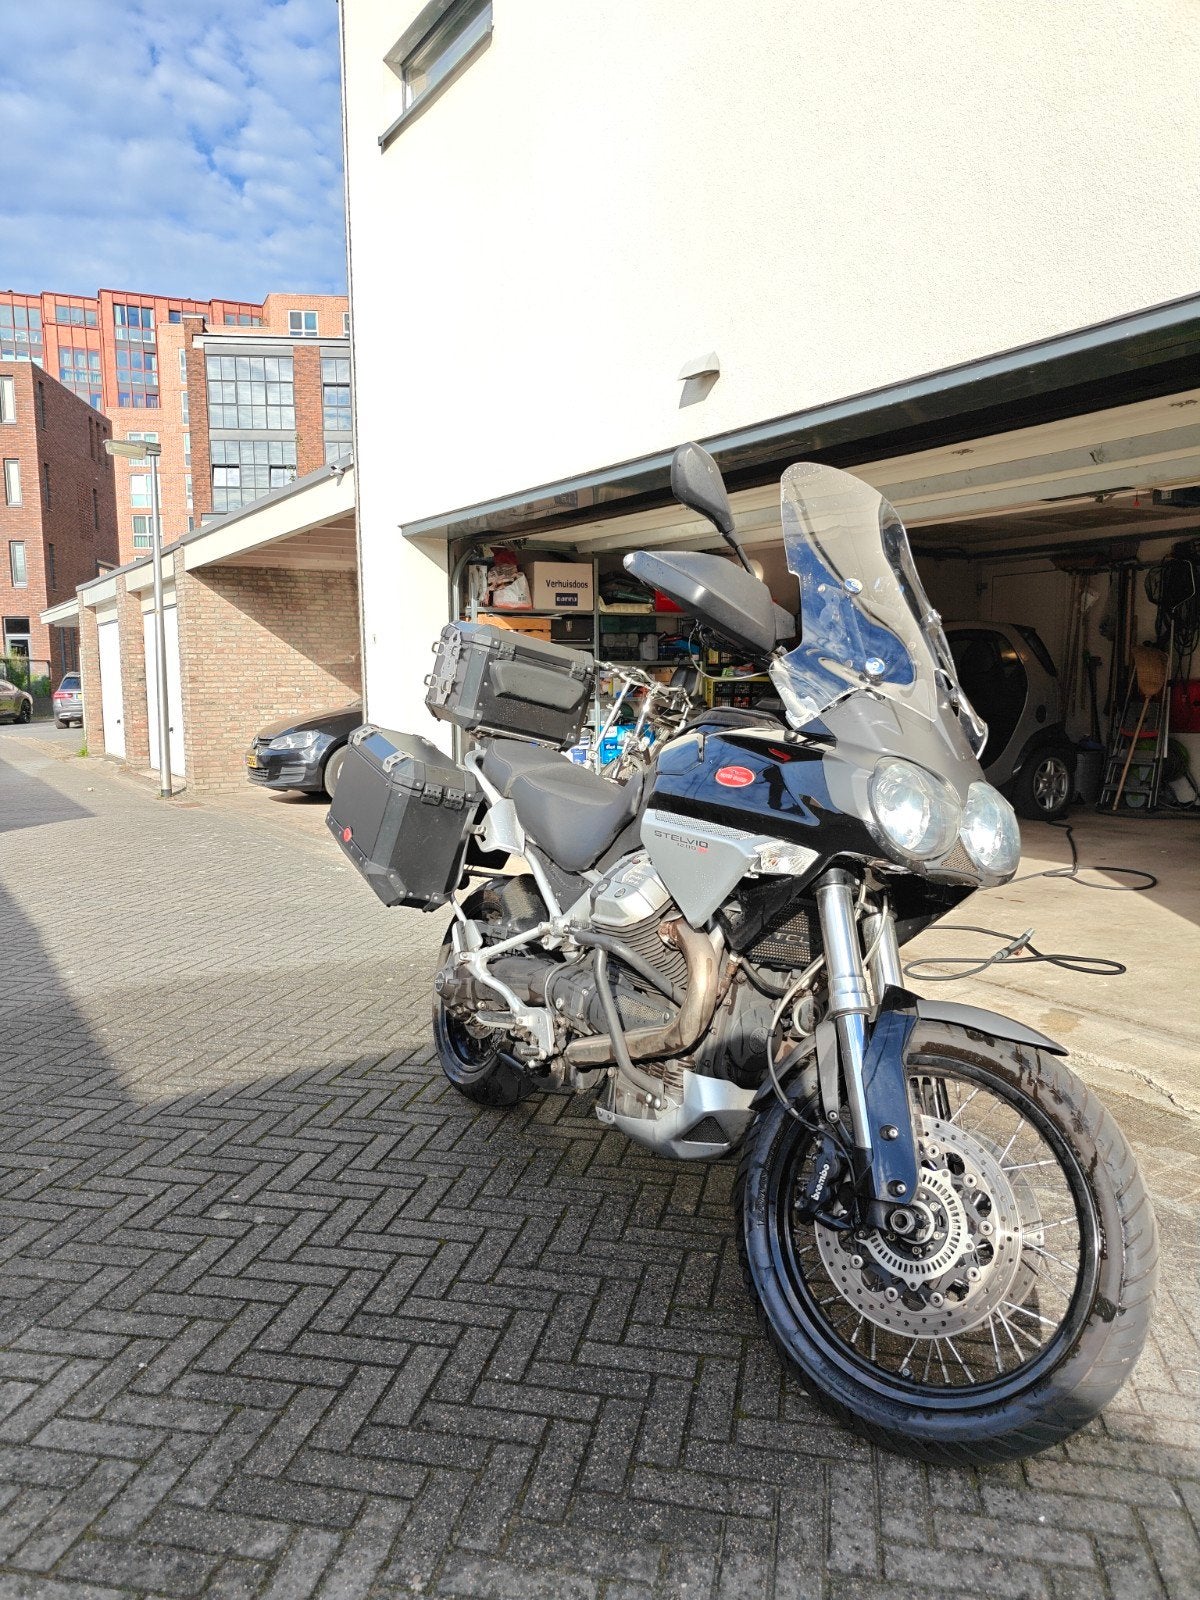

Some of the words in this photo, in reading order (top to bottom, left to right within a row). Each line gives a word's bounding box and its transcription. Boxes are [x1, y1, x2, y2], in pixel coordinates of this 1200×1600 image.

[545, 579, 589, 589] Verhuisdoos
[654, 829, 709, 849] STELVIO
[811, 1163, 830, 1201] brembo
